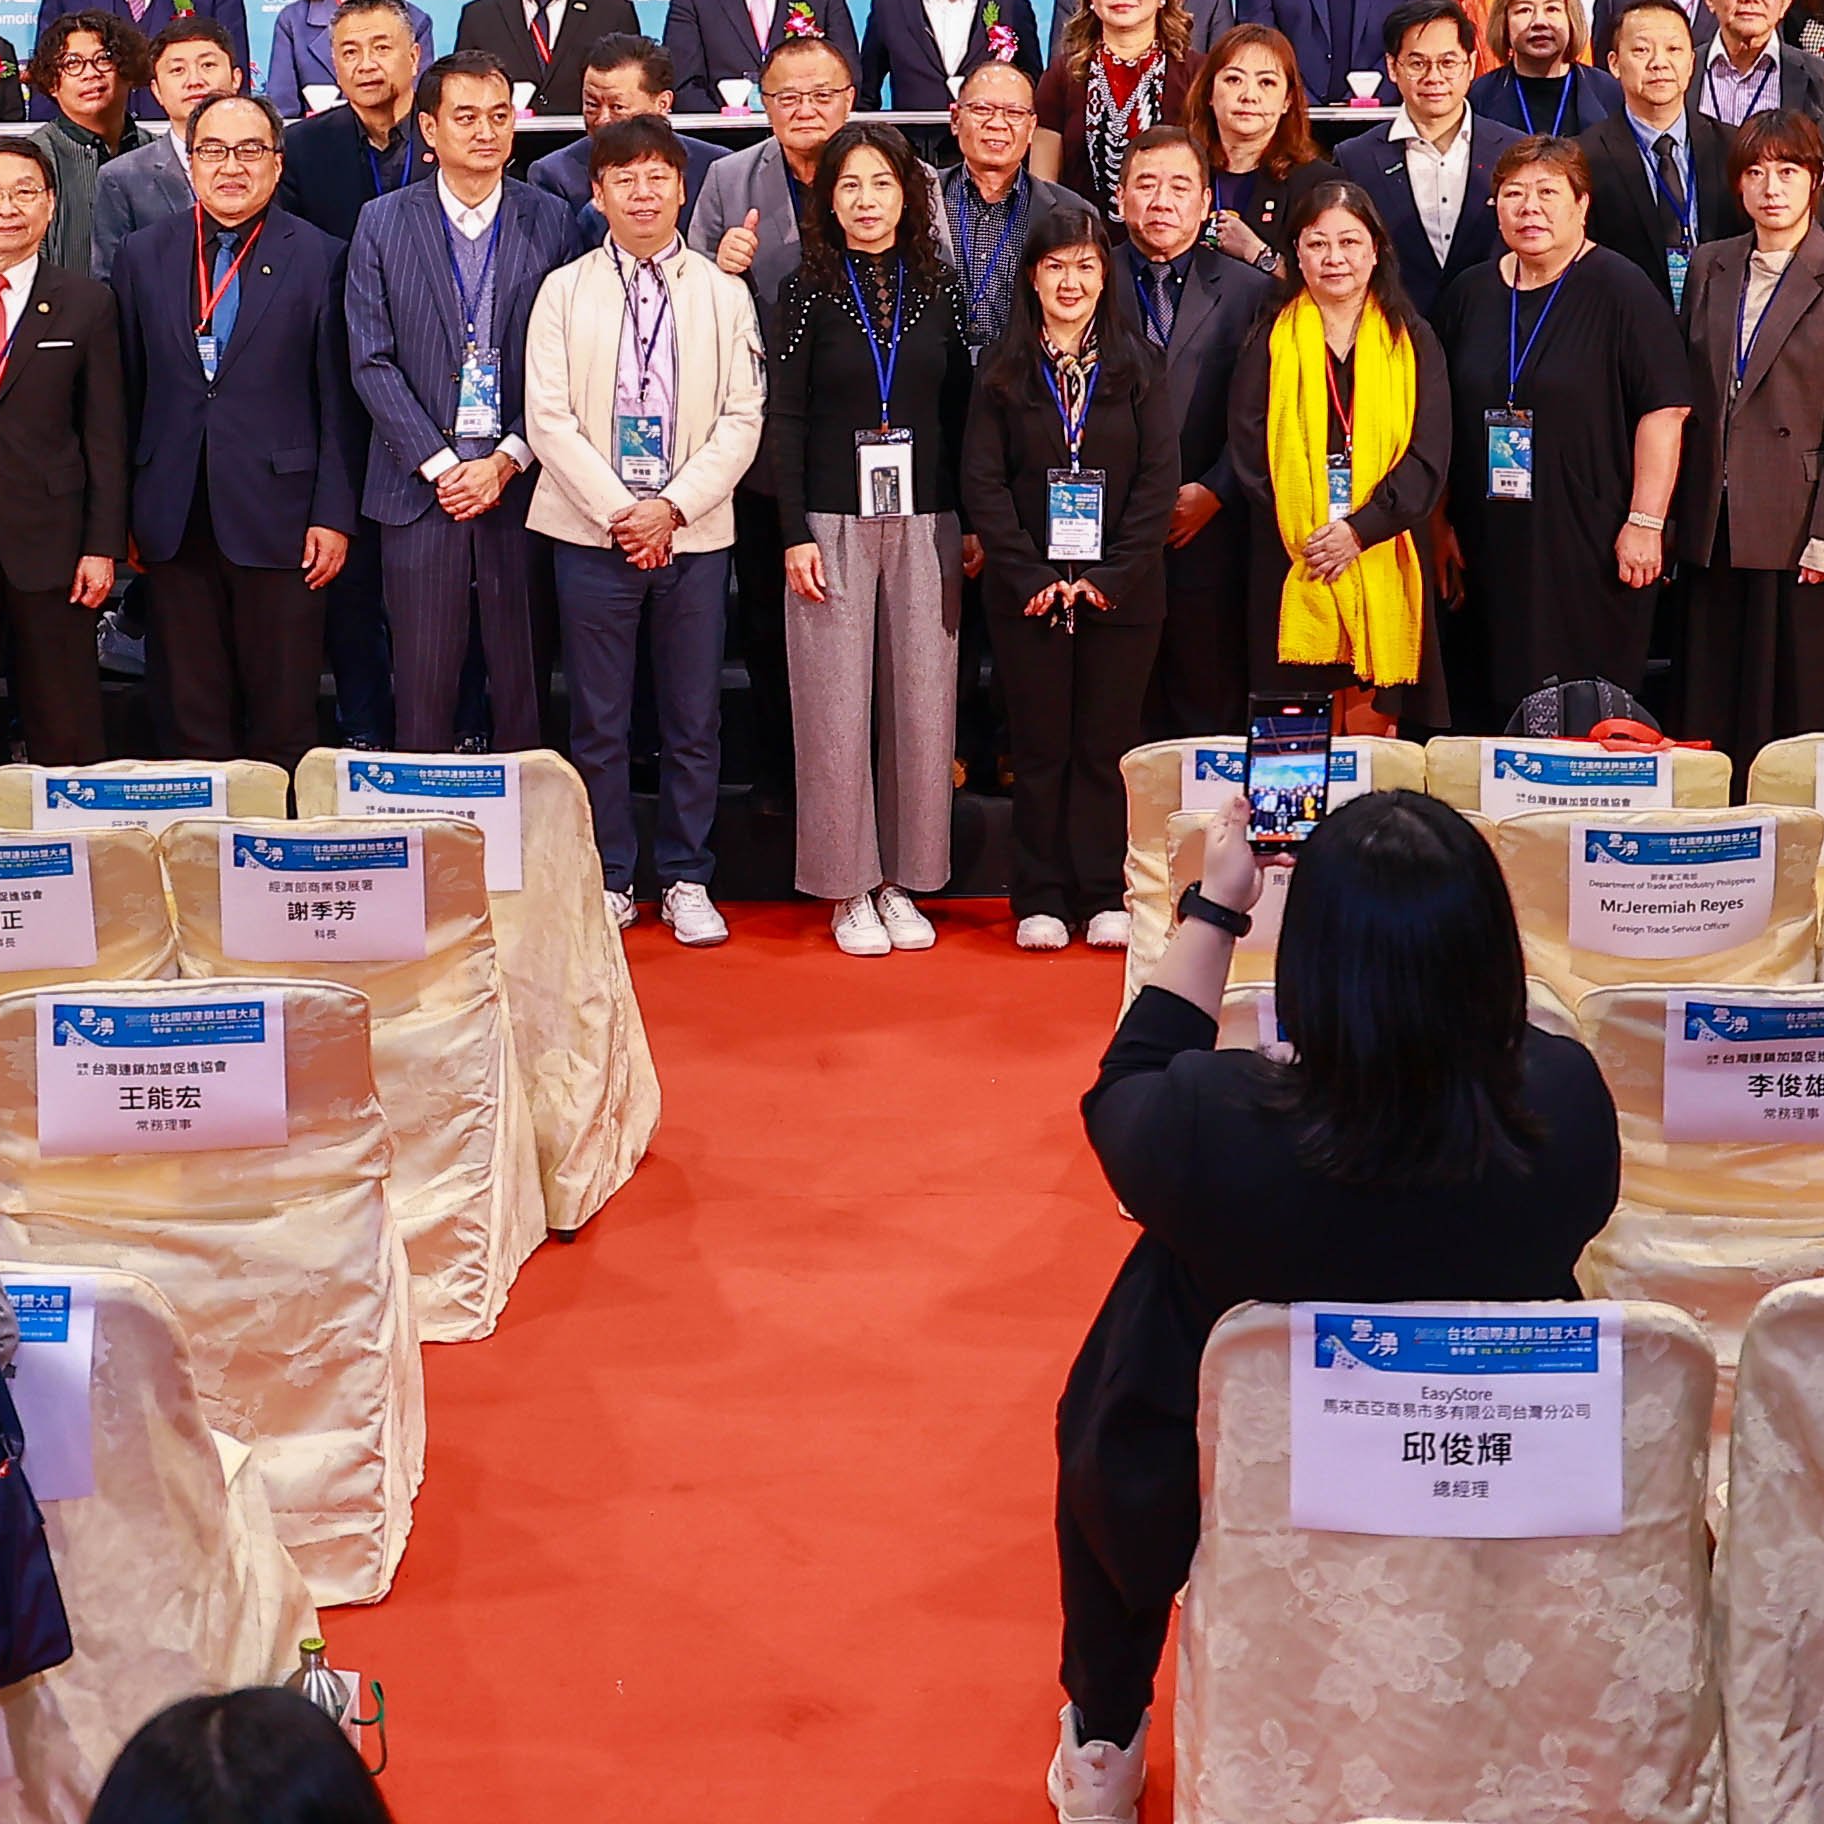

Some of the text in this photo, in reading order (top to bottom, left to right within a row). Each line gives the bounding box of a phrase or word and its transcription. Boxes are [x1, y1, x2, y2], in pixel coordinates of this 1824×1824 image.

[1528, 794, 1631, 807] 台灣連鎖加盟促進協會
[268, 880, 373, 893] 經濟部商業發展署
[1589, 880, 1635, 890] Department
[1647, 881, 1667, 889] Trade
[1684, 880, 1714, 890] Industry
[1716, 877, 1755, 888] Philippines
[287, 901, 357, 922] 謝季芳
[1601, 897, 1744, 914] Mr.Jeremiah Reyes
[315, 929, 337, 940] 科長
[1613, 922, 1730, 935] Foreign Trade Service Officer
[92, 1060, 227, 1076] 台灣連鎖加盟促進協會
[119, 1087, 201, 1110] 王能宏
[1763, 1108, 1820, 1120] 常務理事
[137, 1119, 192, 1131] 常務理事
[1448, 1326, 1592, 1341] 台北國際連鎖加盟大展
[1422, 1387, 1492, 1404] EasyStore
[1324, 1399, 1590, 1420] 馬來西亞商易市多有限公司台灣分公司
[1402, 1432, 1512, 1466] 邱俊輝
[1433, 1480, 1489, 1498] 總經理
